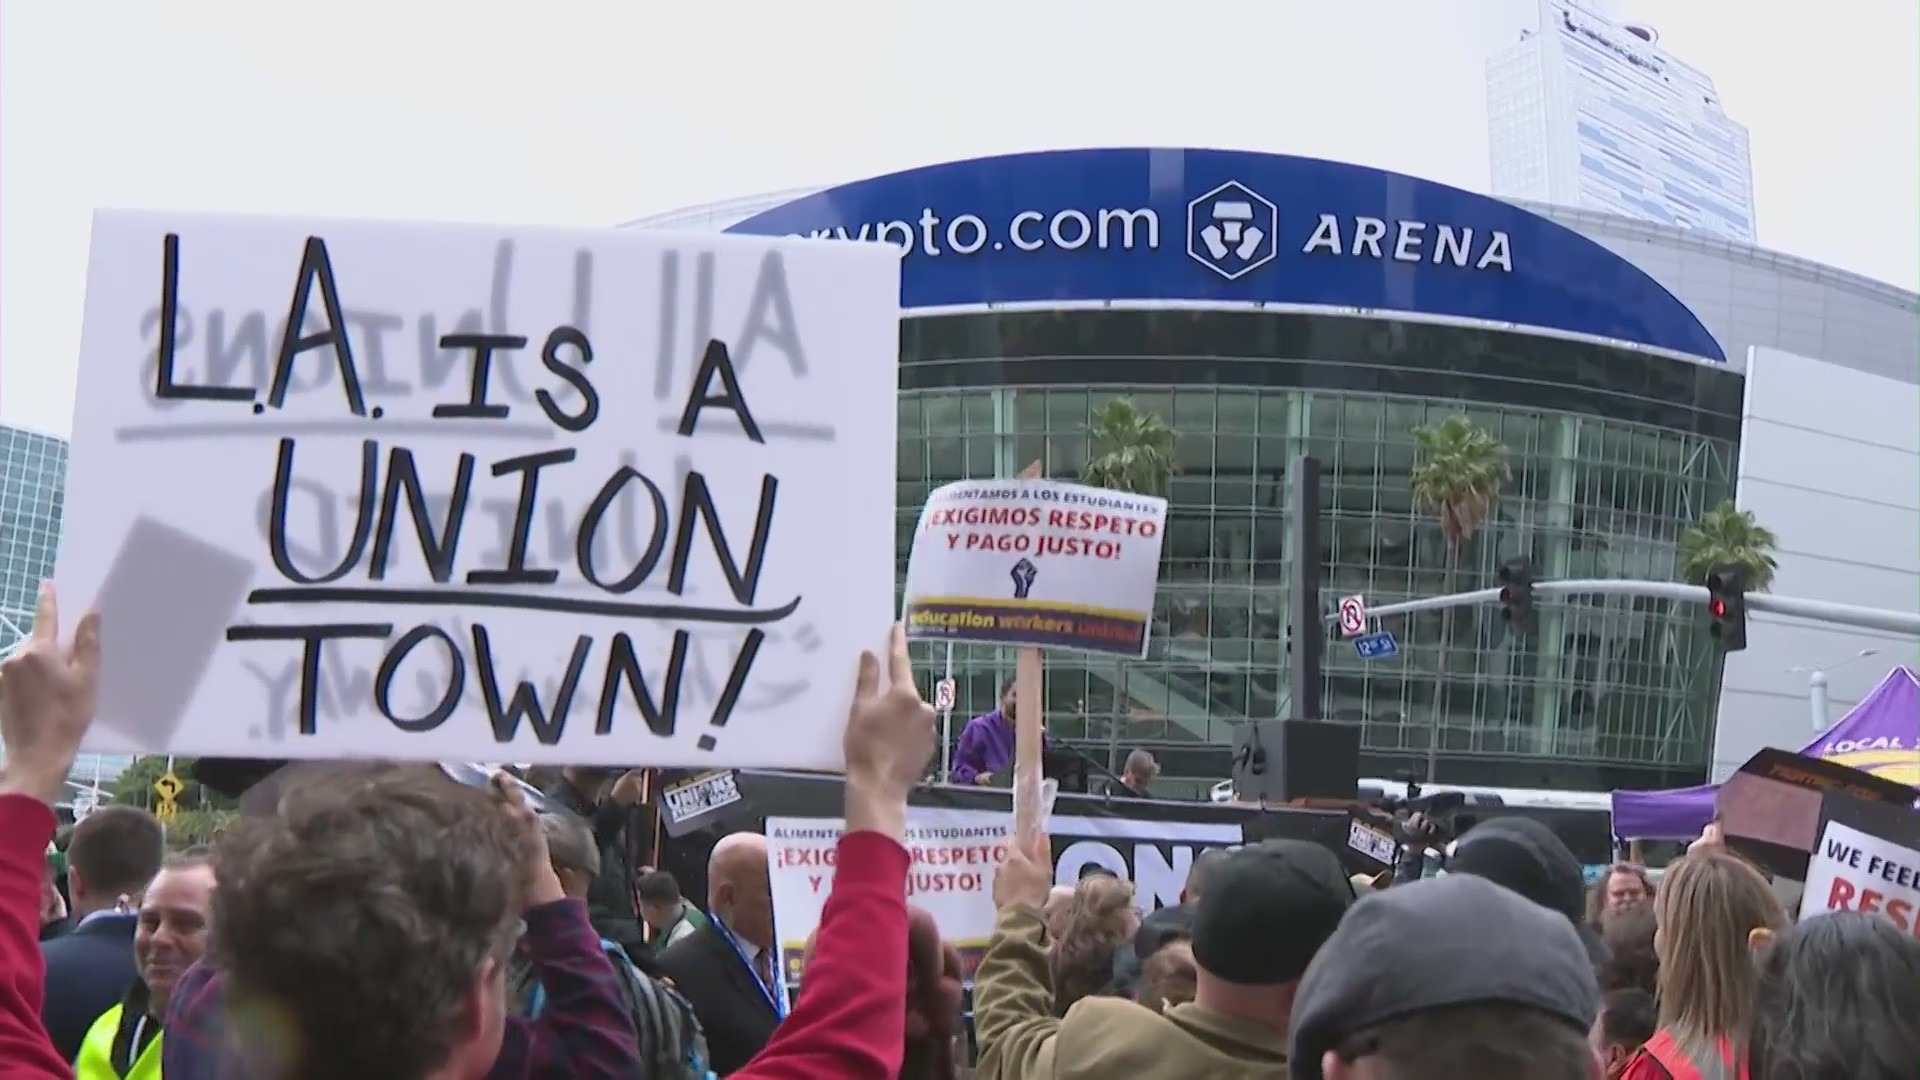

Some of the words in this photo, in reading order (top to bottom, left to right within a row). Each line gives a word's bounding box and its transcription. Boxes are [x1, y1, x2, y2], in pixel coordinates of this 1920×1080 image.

[1302, 213, 1513, 273] ARENA
[156, 232, 384, 418] L.A.
[433, 324, 600, 432] IS
[677, 337, 766, 444] A
[1020, 489, 1031, 500] A
[1033, 490, 1059, 501] LOS
[269, 436, 779, 607] UNION
[1048, 509, 1157, 538] RESPETO
[947, 533, 961, 550] Y
[966, 533, 1030, 552] PAGO
[1033, 535, 1123, 560] JUSTO!
[999, 614, 1073, 632] workers
[225, 622, 765, 752] TOWN!
[1822, 736, 1903, 757] LOCAL
[774, 827, 841, 839] ALIMENT
[777, 847, 838, 869] ¡EXIG
[911, 845, 1009, 865] RESPETO
[1827, 838, 1863, 869] WE
[808, 874, 823, 892] Y
[907, 872, 983, 896] JUSTO!
[1826, 876, 1920, 938] RES
